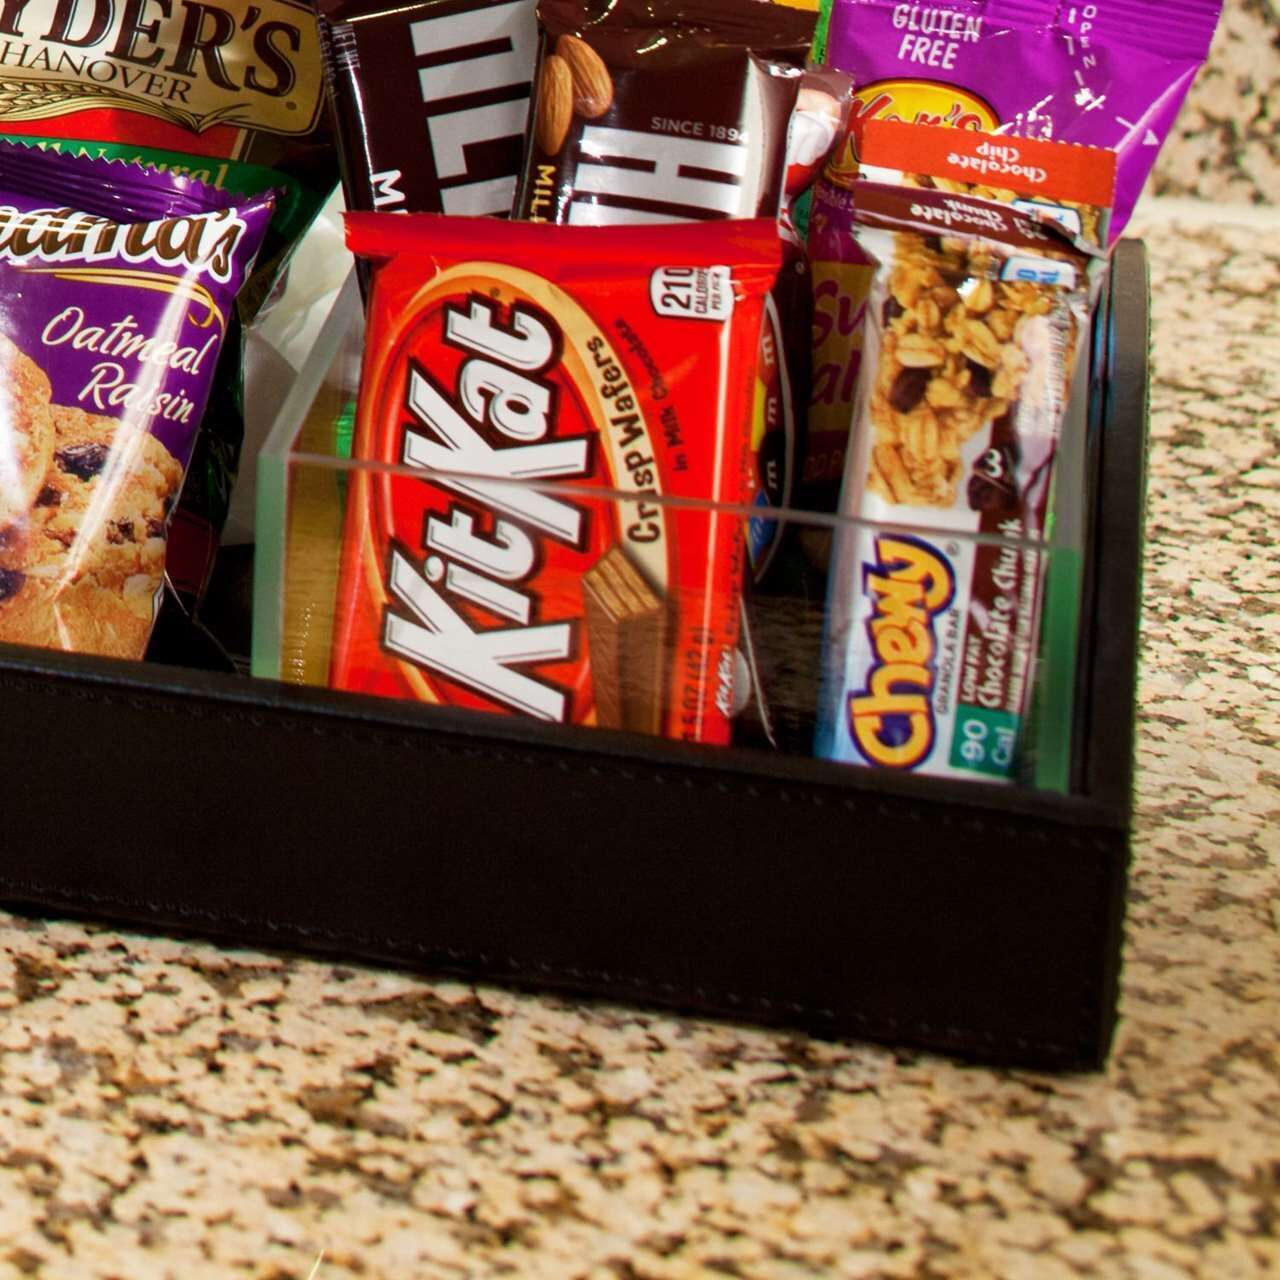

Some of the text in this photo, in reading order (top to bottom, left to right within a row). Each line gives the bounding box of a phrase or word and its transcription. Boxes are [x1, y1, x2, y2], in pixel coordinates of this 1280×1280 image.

[893, 4, 983, 44] GLUTEN
[1080, 5, 1097, 70] OPEN
[0, 38, 192, 105] HANOVER
[898, 36, 958, 69] FREE
[651, 117, 704, 136] SINCE
[976, 142, 1019, 162] Chip
[947, 152, 1047, 183] Chocolate
[910, 203, 1008, 231] Chocolate
[661, 267, 694, 310] 210
[41, 305, 217, 376] Oatmeal
[77, 361, 194, 424] Raisin
[587, 335, 661, 544] Crisp Wafers
[382, 295, 593, 722] KitKat
[850, 537, 955, 767] Chewy
[961, 635, 982, 703] LOW FAT
[978, 593, 1012, 708] Chocolate
[960, 719, 988, 762] 90
[992, 727, 1015, 766] Cal
